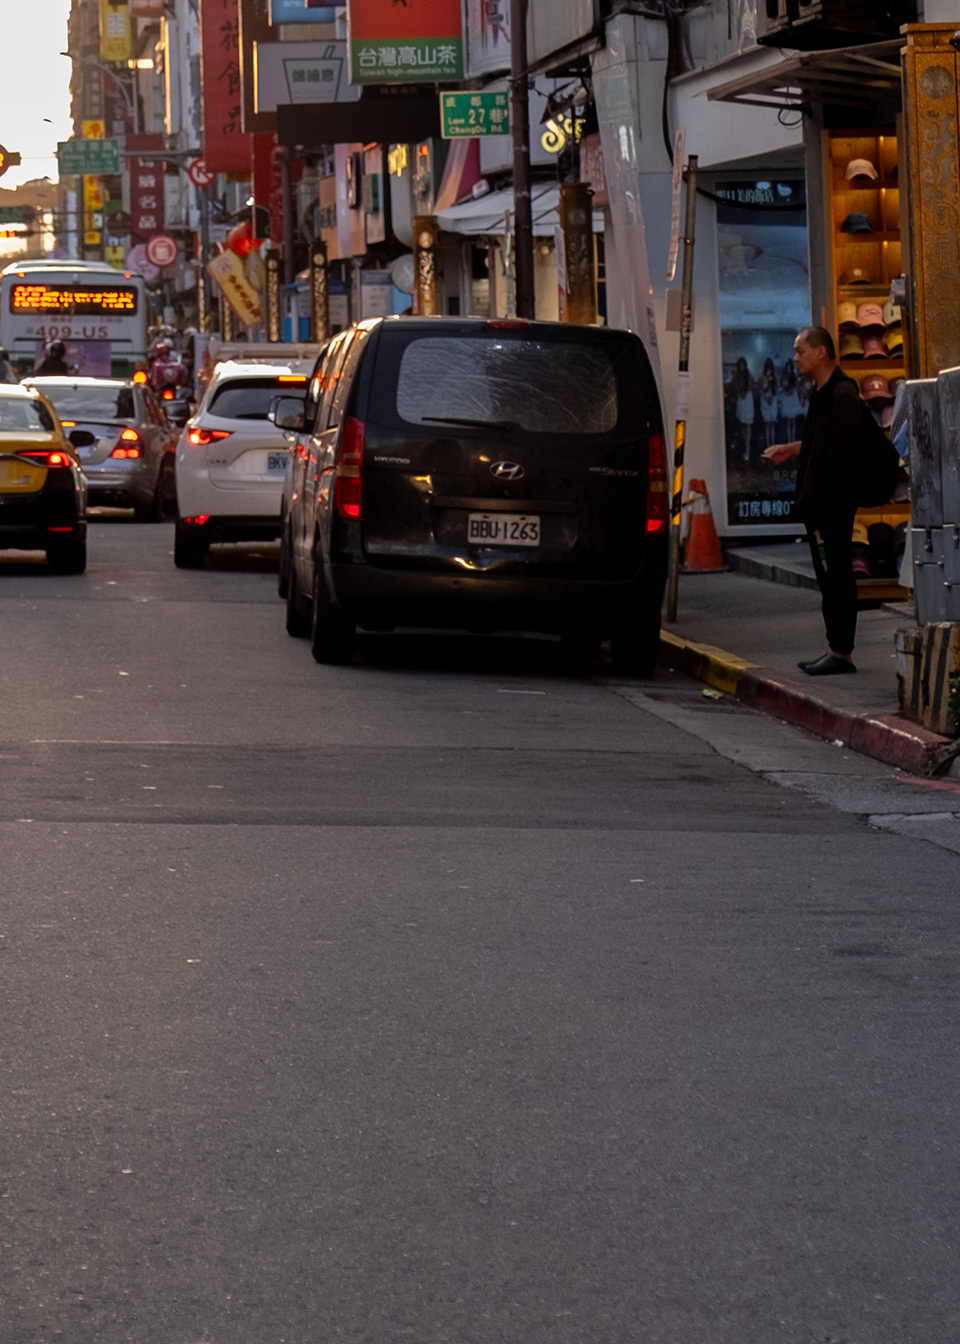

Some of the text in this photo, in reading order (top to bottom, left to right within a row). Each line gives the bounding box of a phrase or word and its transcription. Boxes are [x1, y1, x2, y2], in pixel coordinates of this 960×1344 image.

[358, 45, 457, 67] 台灣高山茶
[36, 326, 109, 339] 409-U5
[470, 520, 538, 541] BBU-1263
